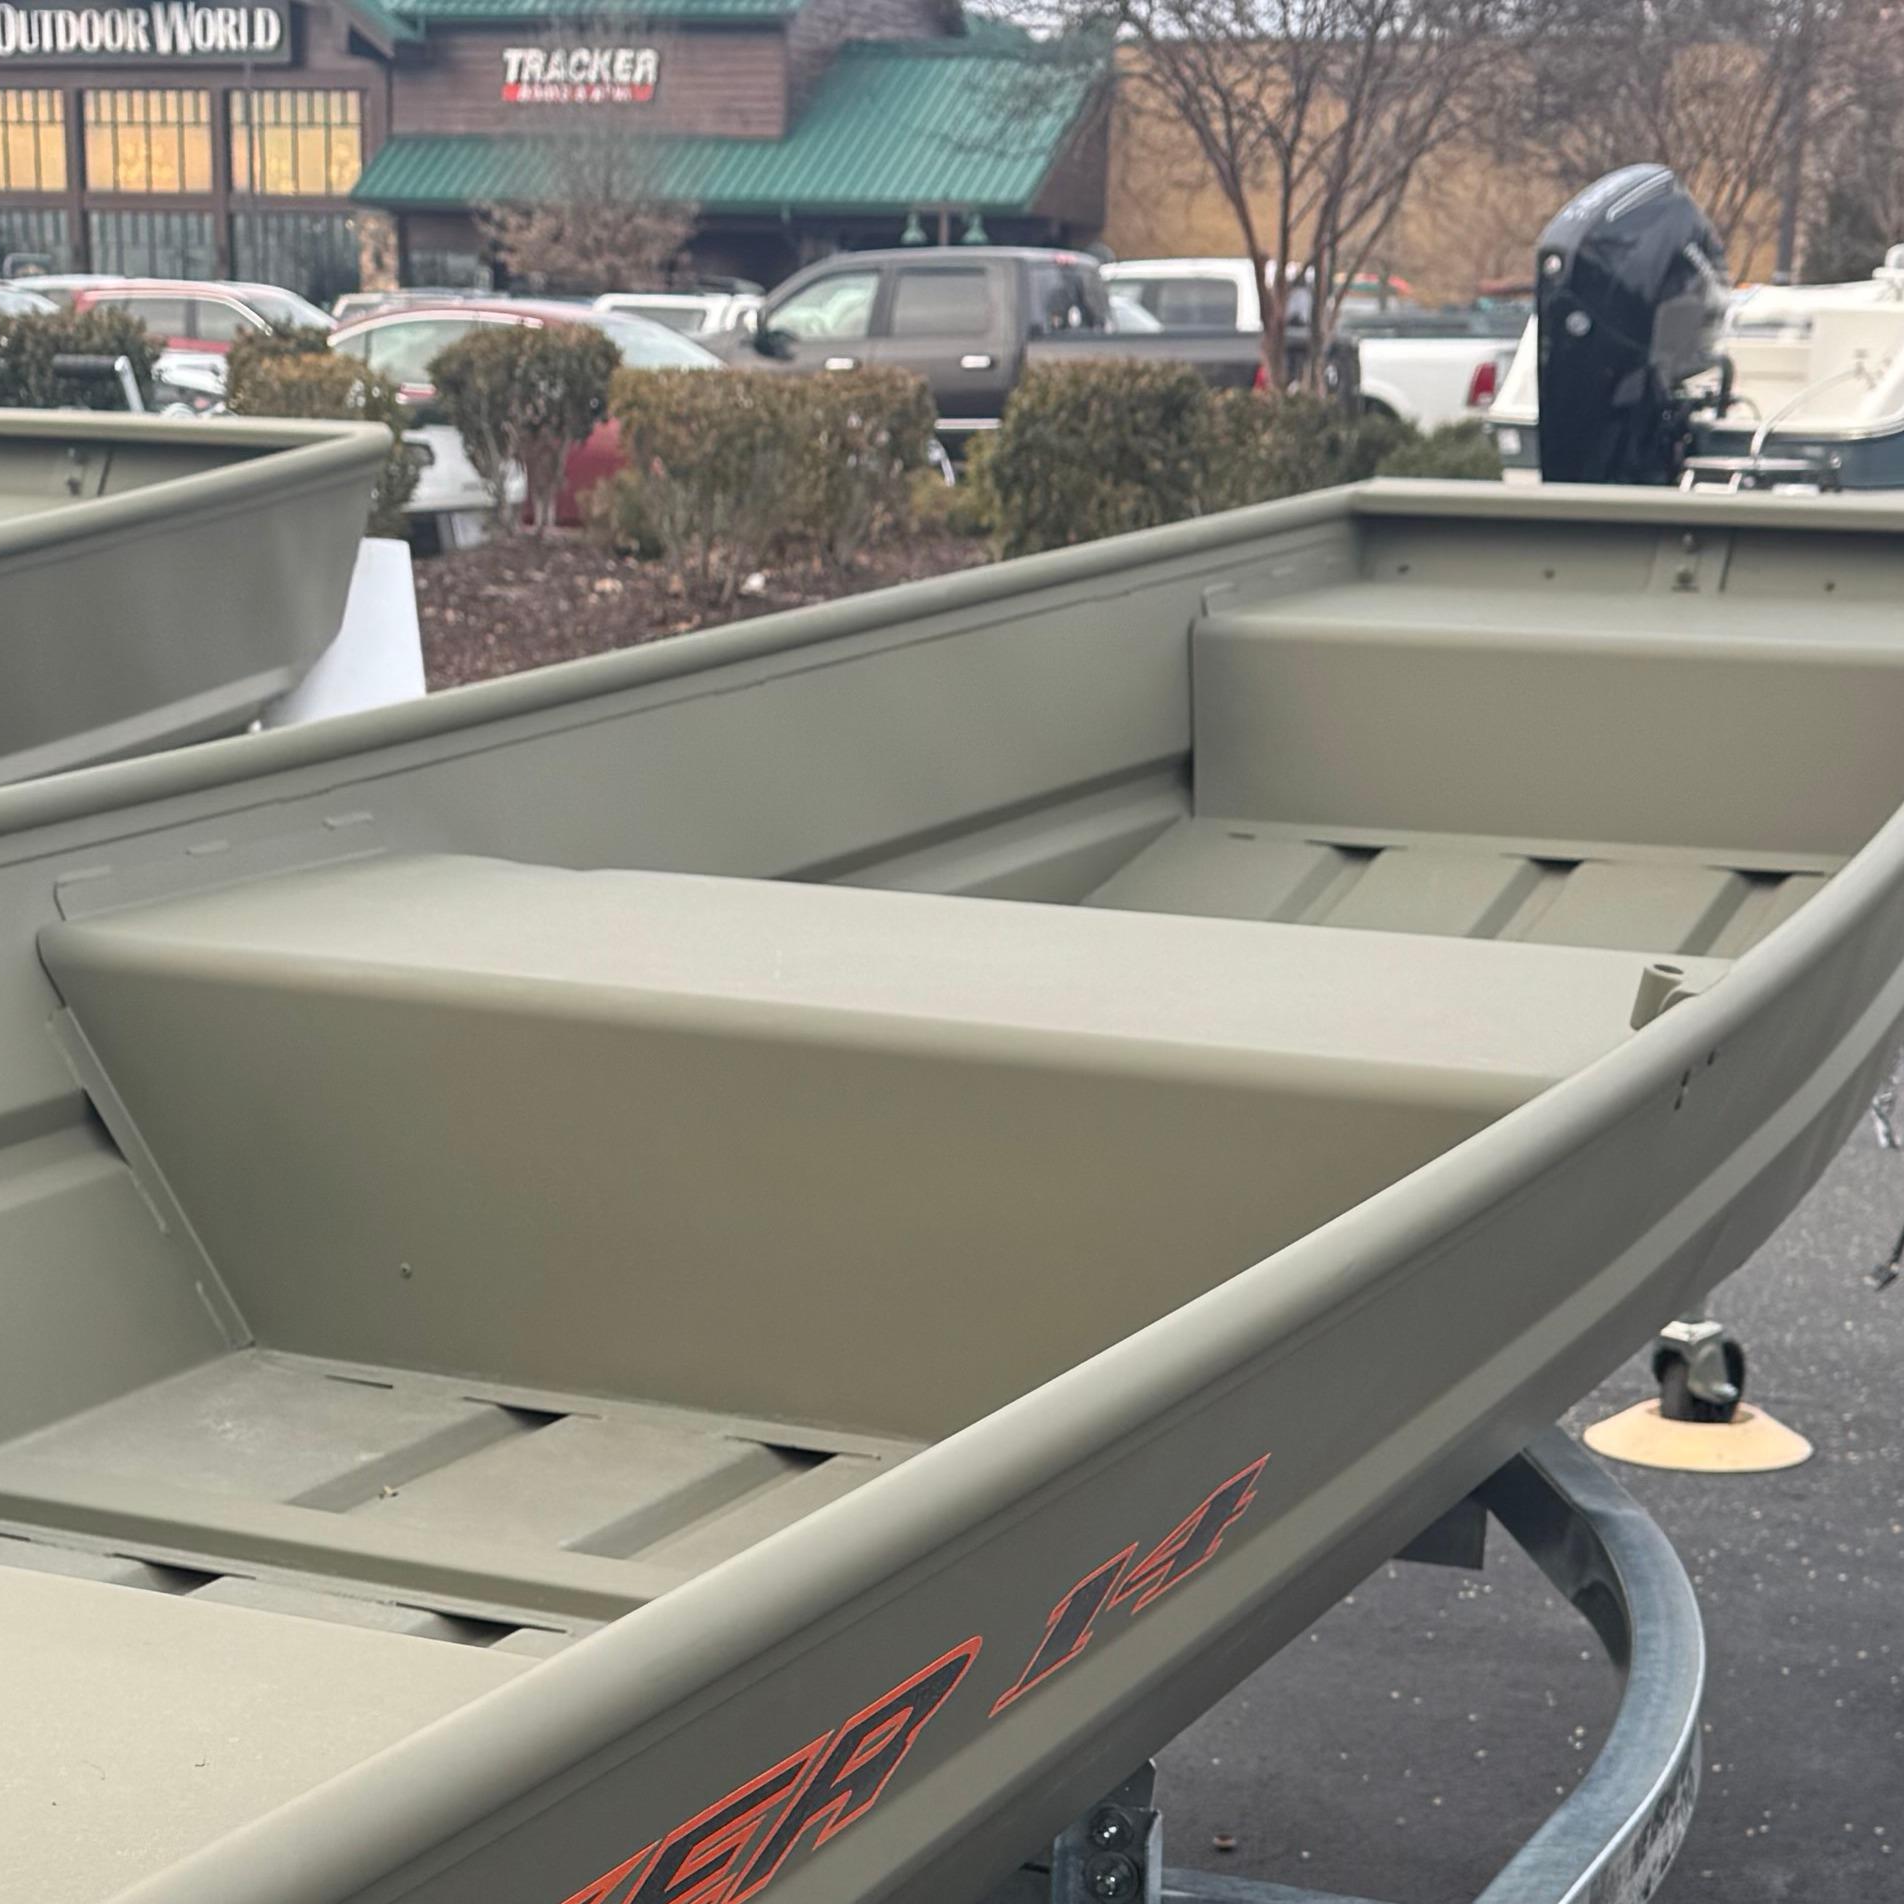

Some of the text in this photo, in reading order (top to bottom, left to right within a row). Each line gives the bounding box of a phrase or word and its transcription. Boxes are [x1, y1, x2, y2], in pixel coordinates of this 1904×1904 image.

[152, 1, 281, 54] WORLD
[502, 47, 659, 84] TRACKER
[987, 1452, 1271, 1720] 14
